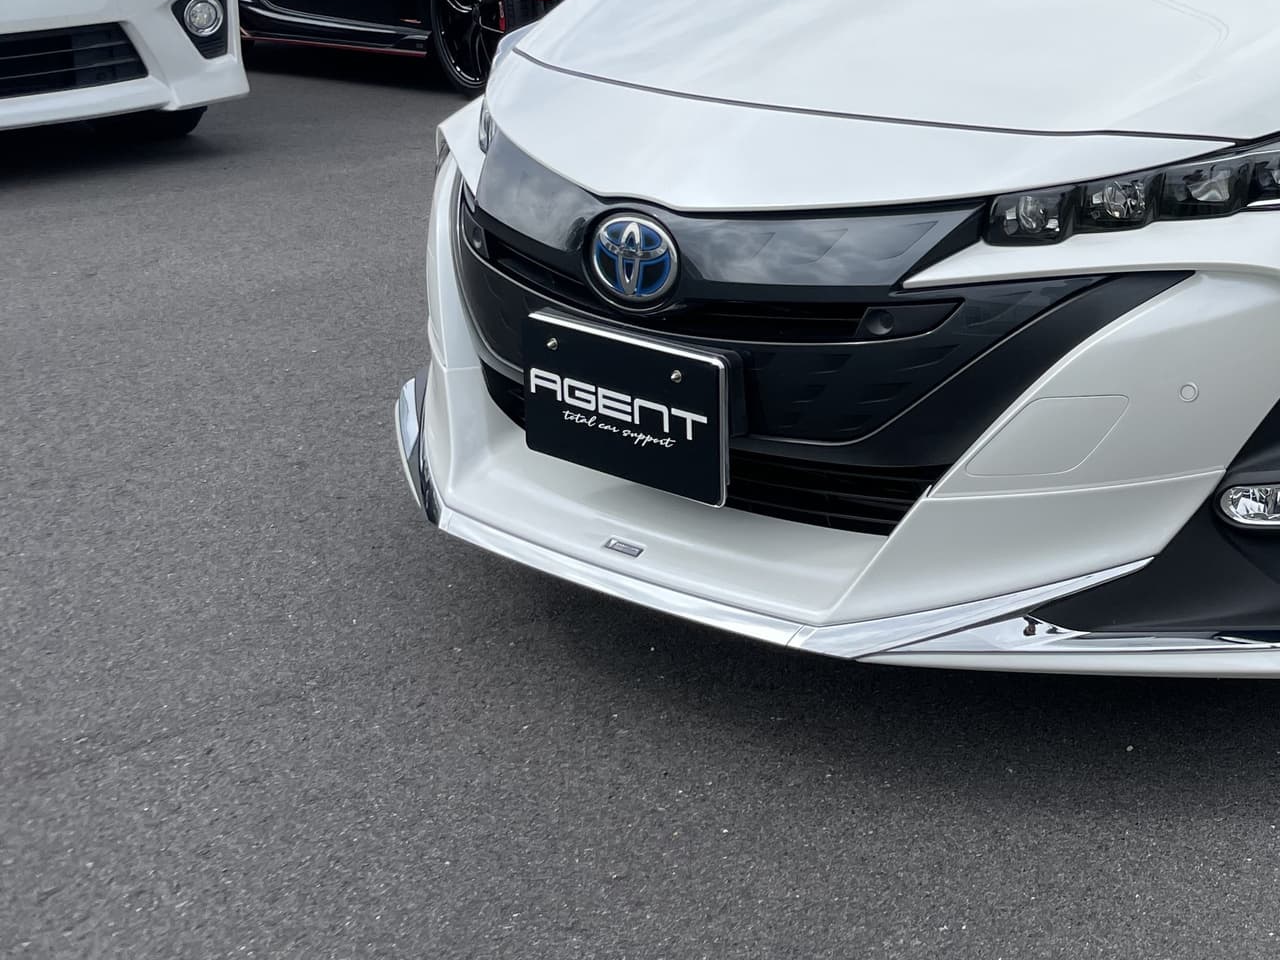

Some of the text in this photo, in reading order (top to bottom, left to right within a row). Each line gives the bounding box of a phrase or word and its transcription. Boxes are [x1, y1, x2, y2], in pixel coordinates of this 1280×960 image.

[530, 368, 707, 440] AGENT
[563, 410, 676, 448] total car support
